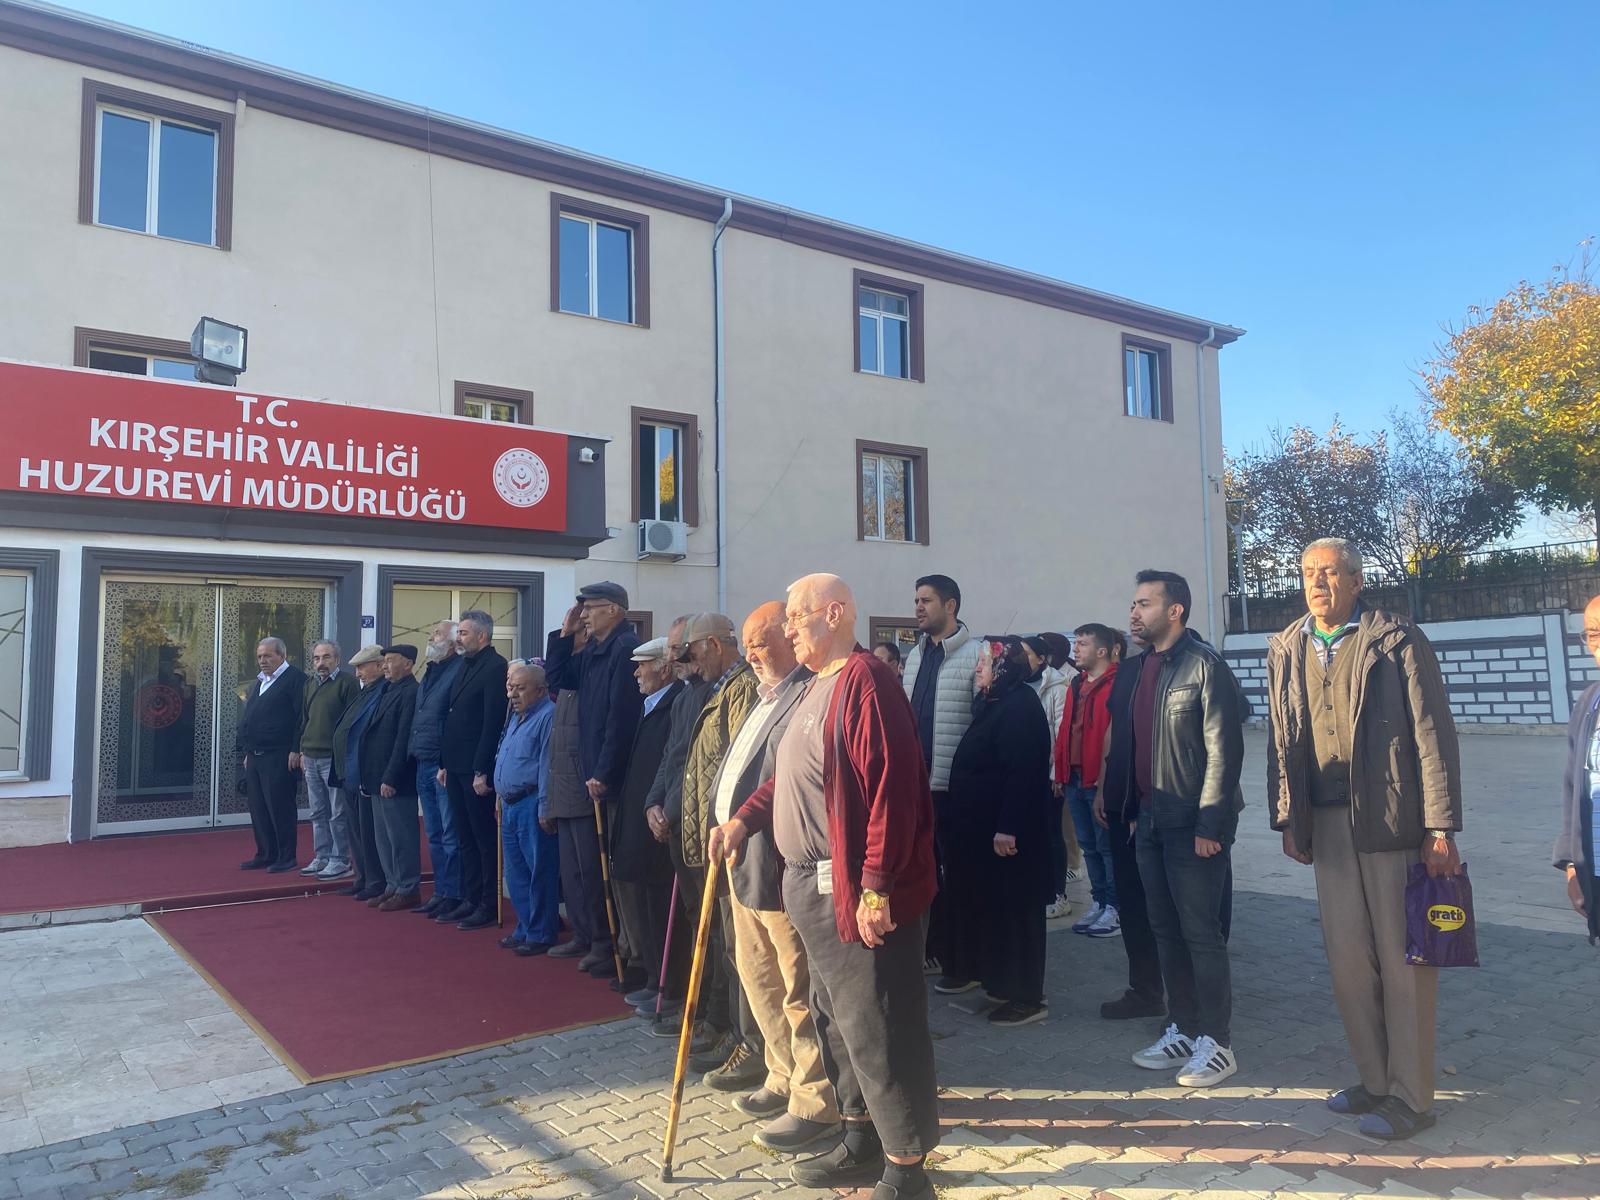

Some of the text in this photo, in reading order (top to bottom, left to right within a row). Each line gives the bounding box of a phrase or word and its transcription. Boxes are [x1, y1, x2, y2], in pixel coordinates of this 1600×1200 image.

[235, 394, 298, 429] T.C.
[90, 417, 418, 478] KIRŞEHİR VALİLİĞİ
[19, 457, 232, 503] HUZUREVİ
[242, 474, 466, 521] MÜDÜRLÜĞÜ
[1429, 908, 1463, 922] gratis
